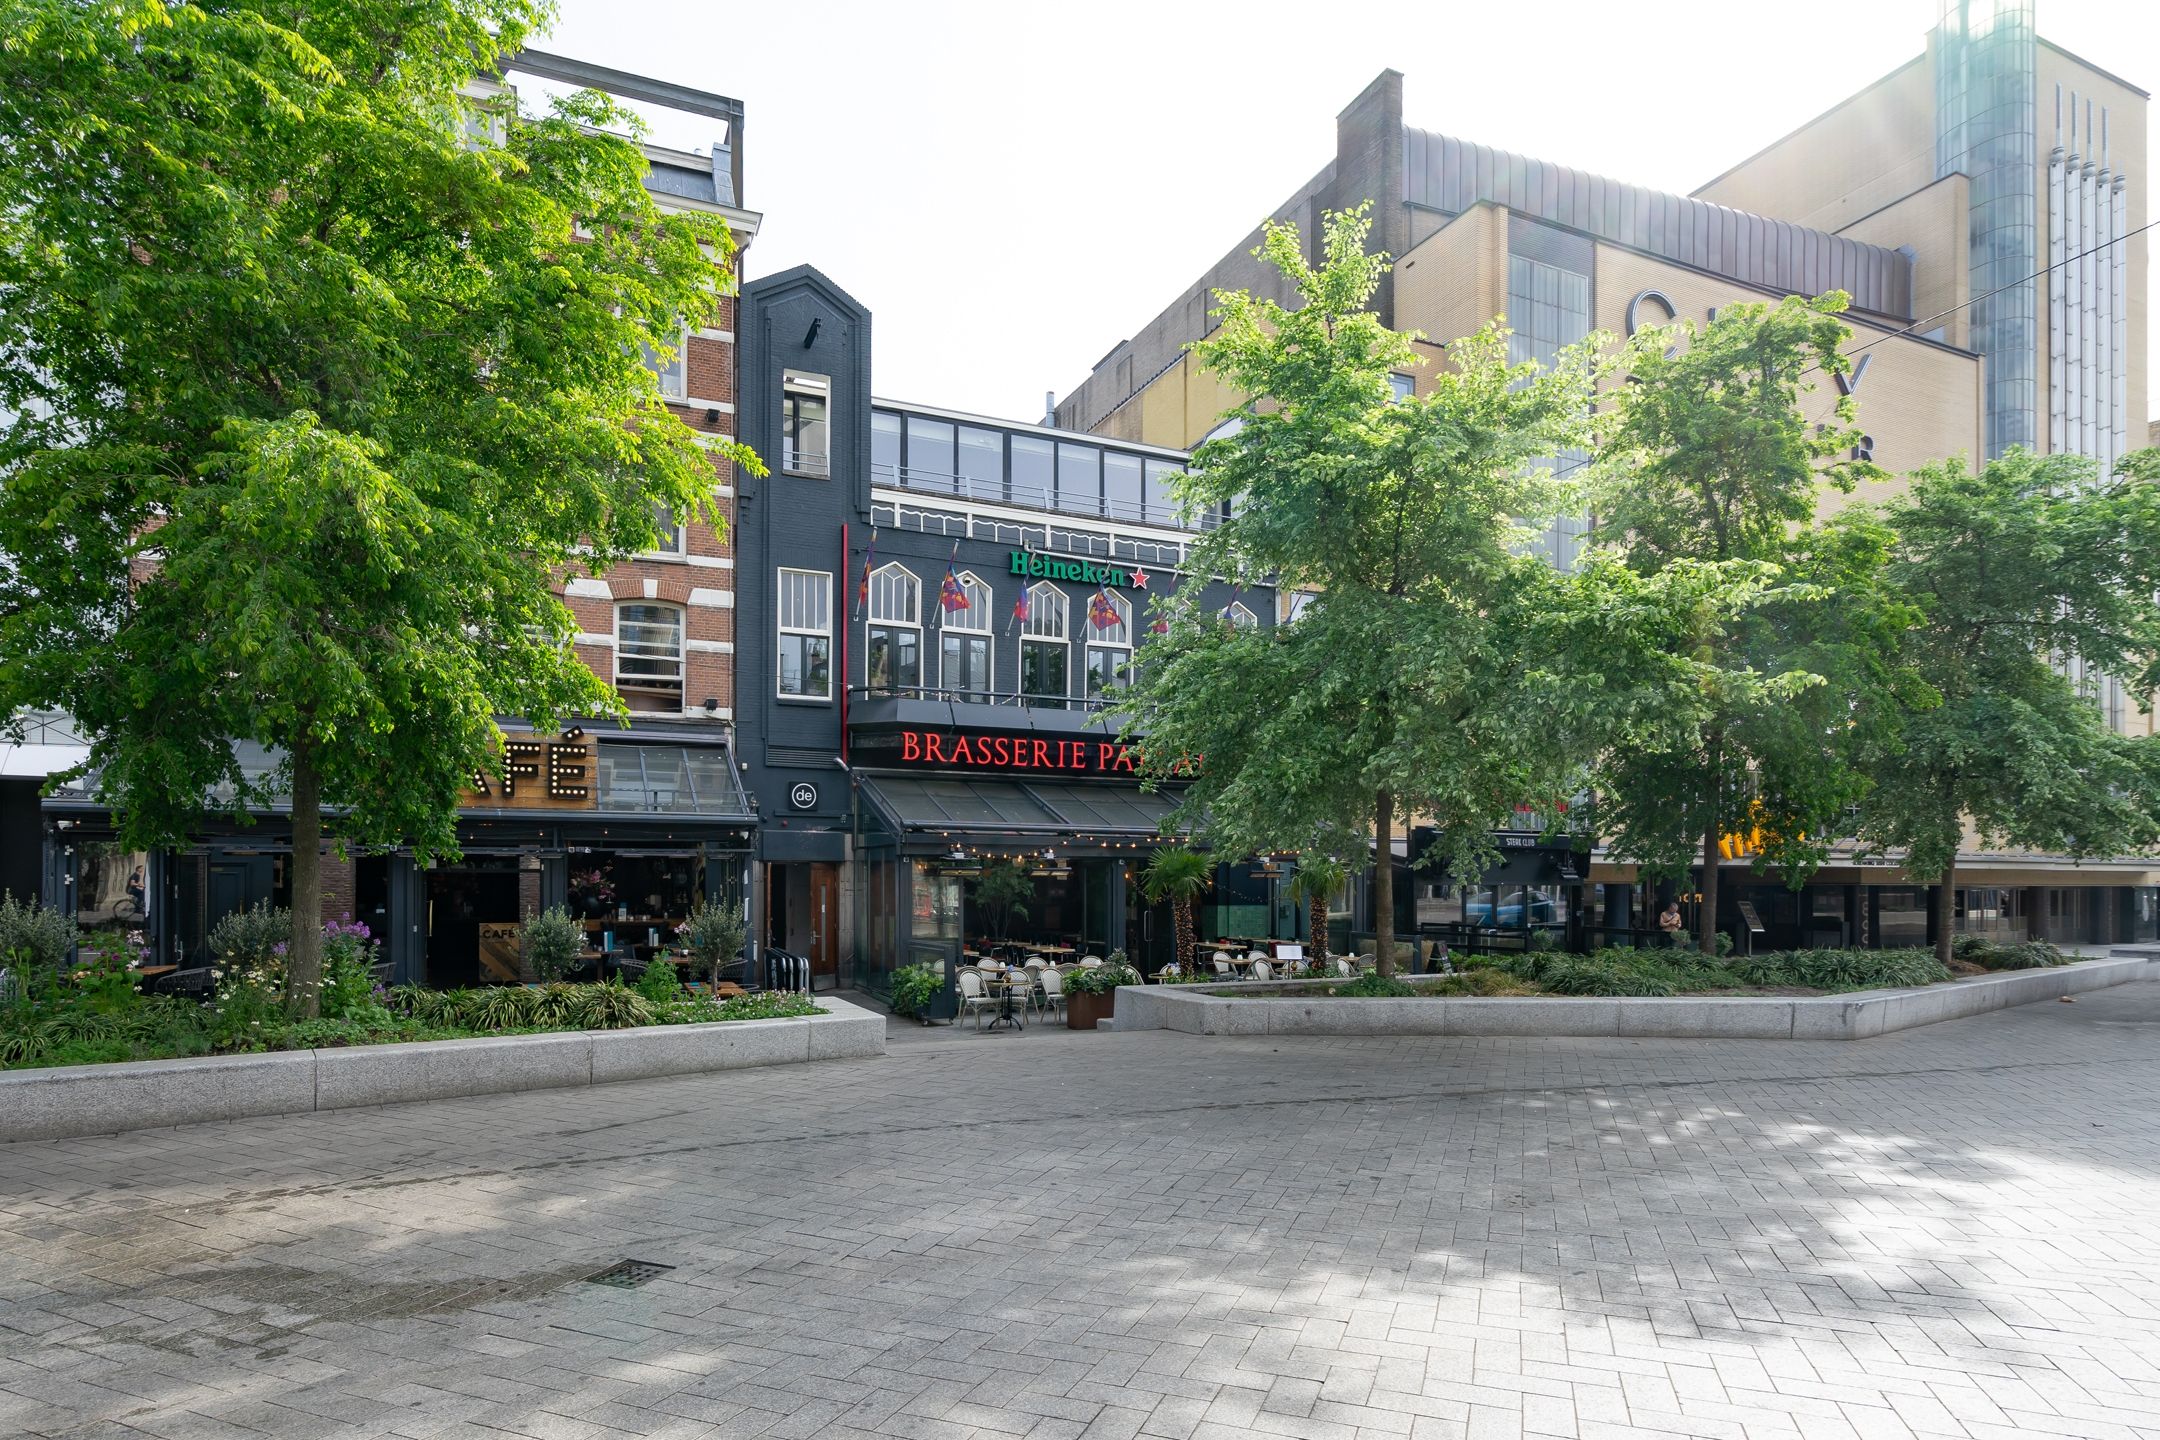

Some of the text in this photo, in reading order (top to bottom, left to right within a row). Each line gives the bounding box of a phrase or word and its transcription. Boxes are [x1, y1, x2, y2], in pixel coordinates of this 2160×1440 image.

[1010, 551, 1126, 586] Heineken
[902, 731, 1087, 769] BRASSERIE
[796, 789, 812, 801] de
[483, 926, 515, 938] CAFÉ
